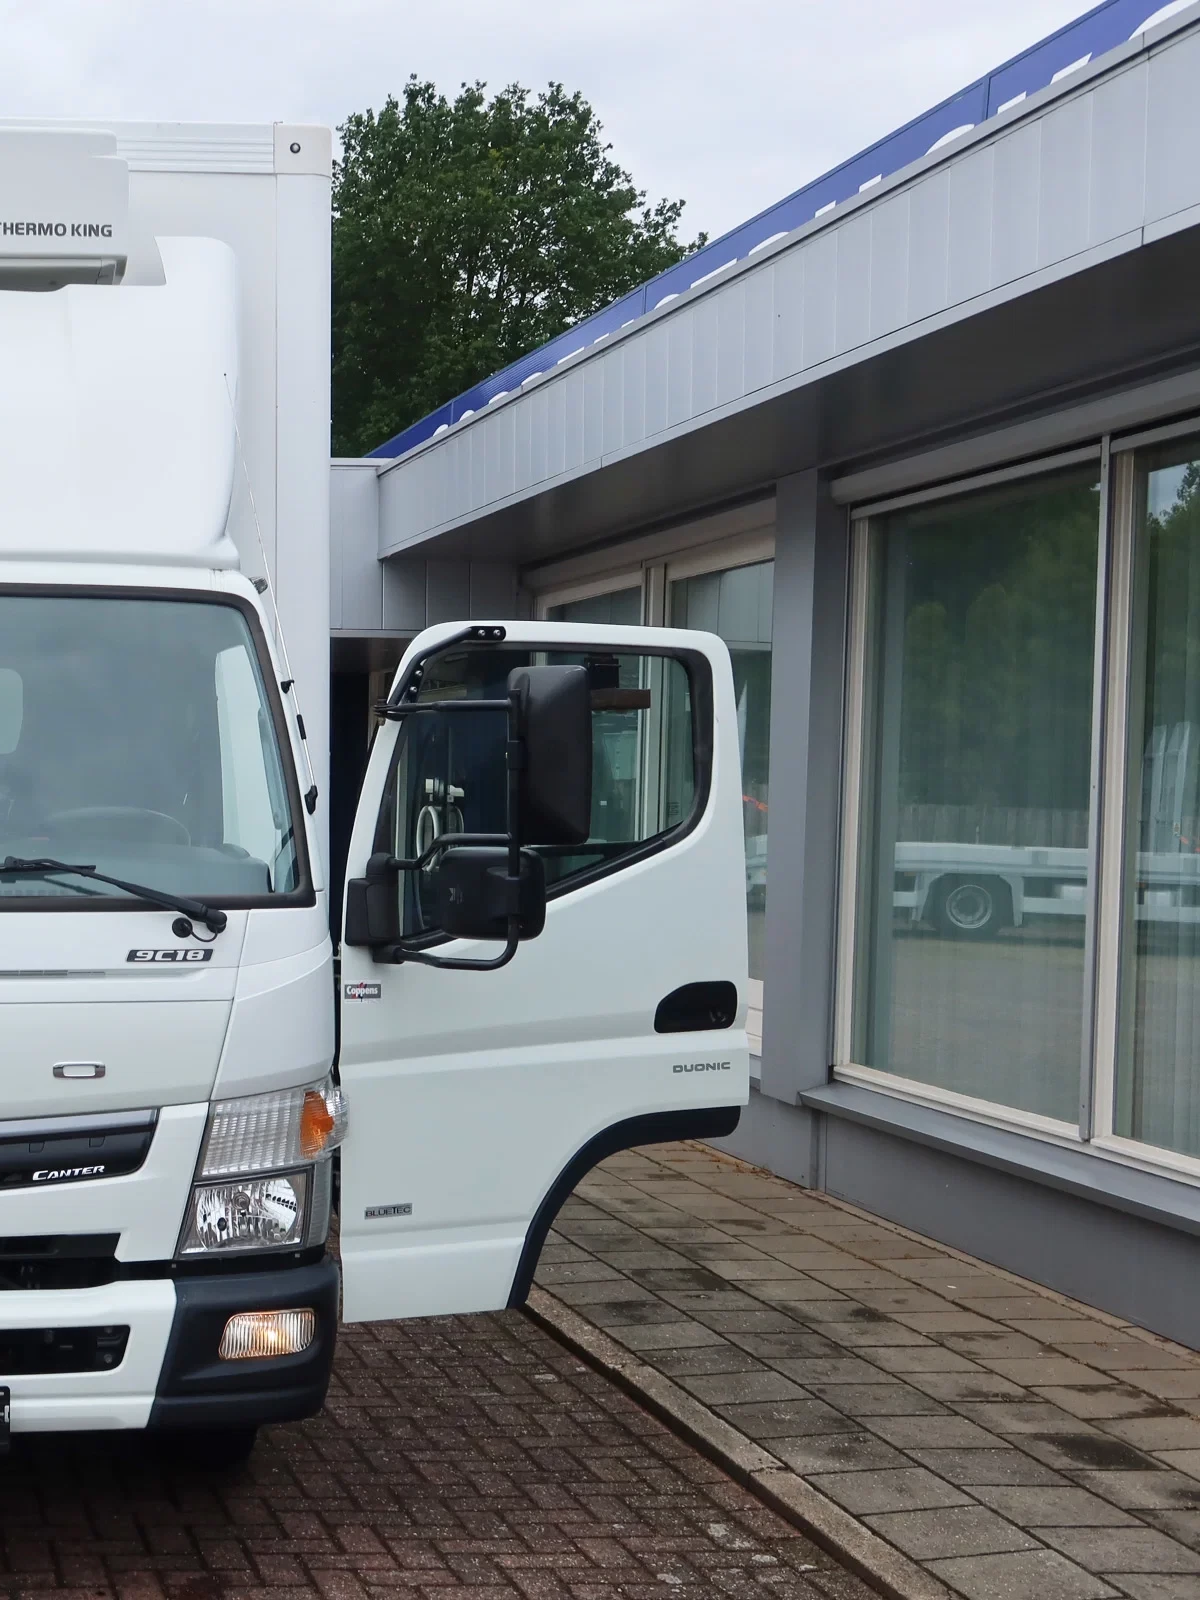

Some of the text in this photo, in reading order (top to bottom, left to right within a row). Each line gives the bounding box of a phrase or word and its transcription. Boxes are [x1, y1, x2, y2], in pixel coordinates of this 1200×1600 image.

[71, 223, 112, 238] KING
[134, 949, 205, 961] 9C18
[346, 985, 378, 998] Coppens
[672, 1061, 731, 1073] DUONIC
